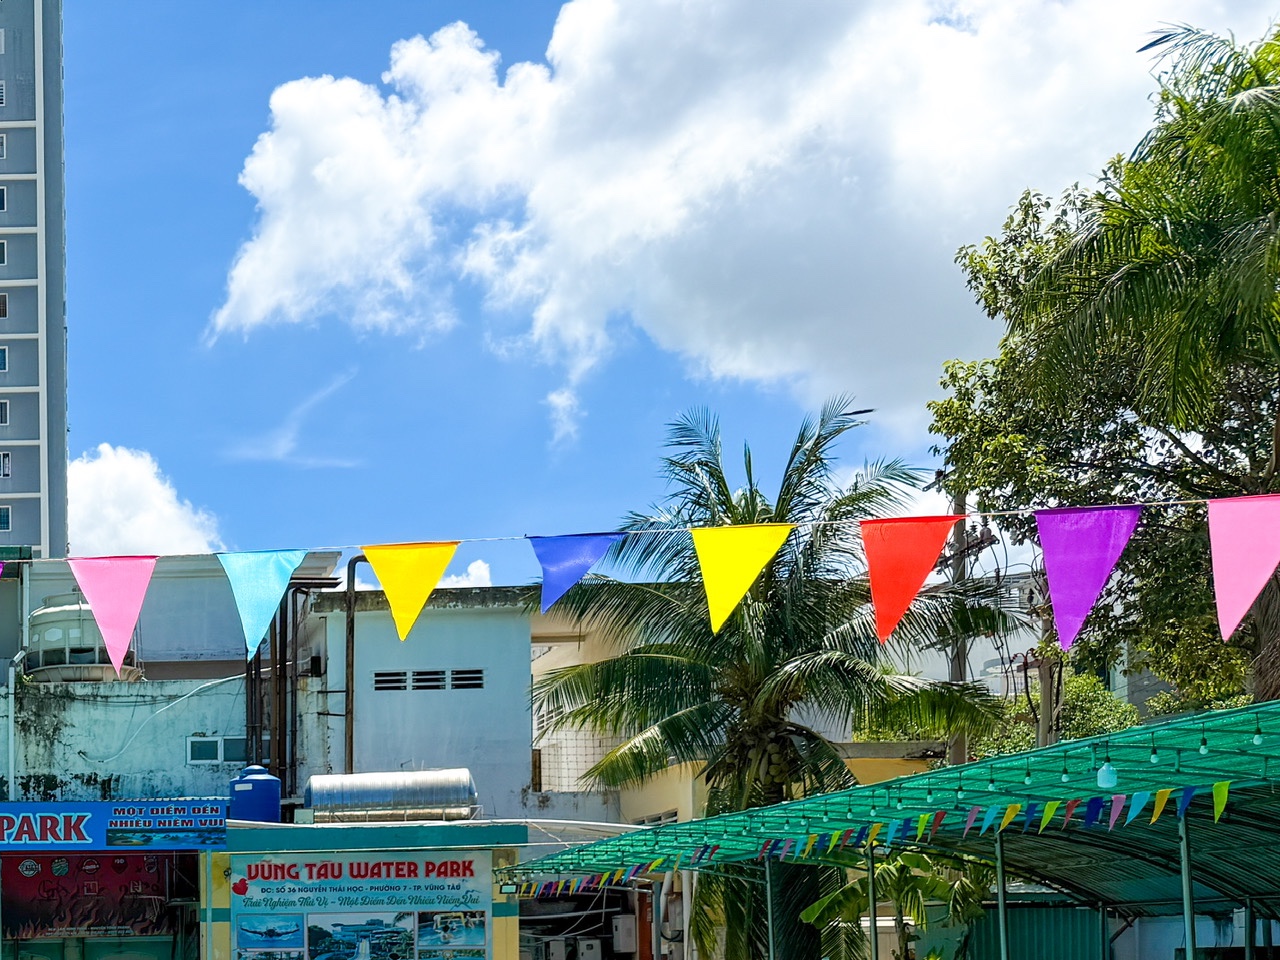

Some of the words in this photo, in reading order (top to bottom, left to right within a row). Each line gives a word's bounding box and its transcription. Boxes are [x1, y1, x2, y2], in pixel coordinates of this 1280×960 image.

[113, 805, 146, 817] MỘT
[150, 803, 187, 816] ĐIỂM
[191, 803, 221, 815] ĐẾN
[108, 816, 153, 828] NHIỀU
[157, 816, 194, 828] NIỀM
[198, 818, 225, 828] VUI
[247, 859, 300, 880] VŨNG
[348, 861, 419, 879] WATER
[424, 859, 475, 878] PARK
[275, 884, 286, 893] SỐ
[329, 885, 345, 893] THÁI
[347, 885, 364, 893] HỌC
[369, 884, 401, 892] PHƯỜNG
[425, 883, 445, 891] VŨNG
[447, 883, 461, 891] TÀU
[338, 896, 359, 909] Một
[461, 894, 480, 905] Vui
